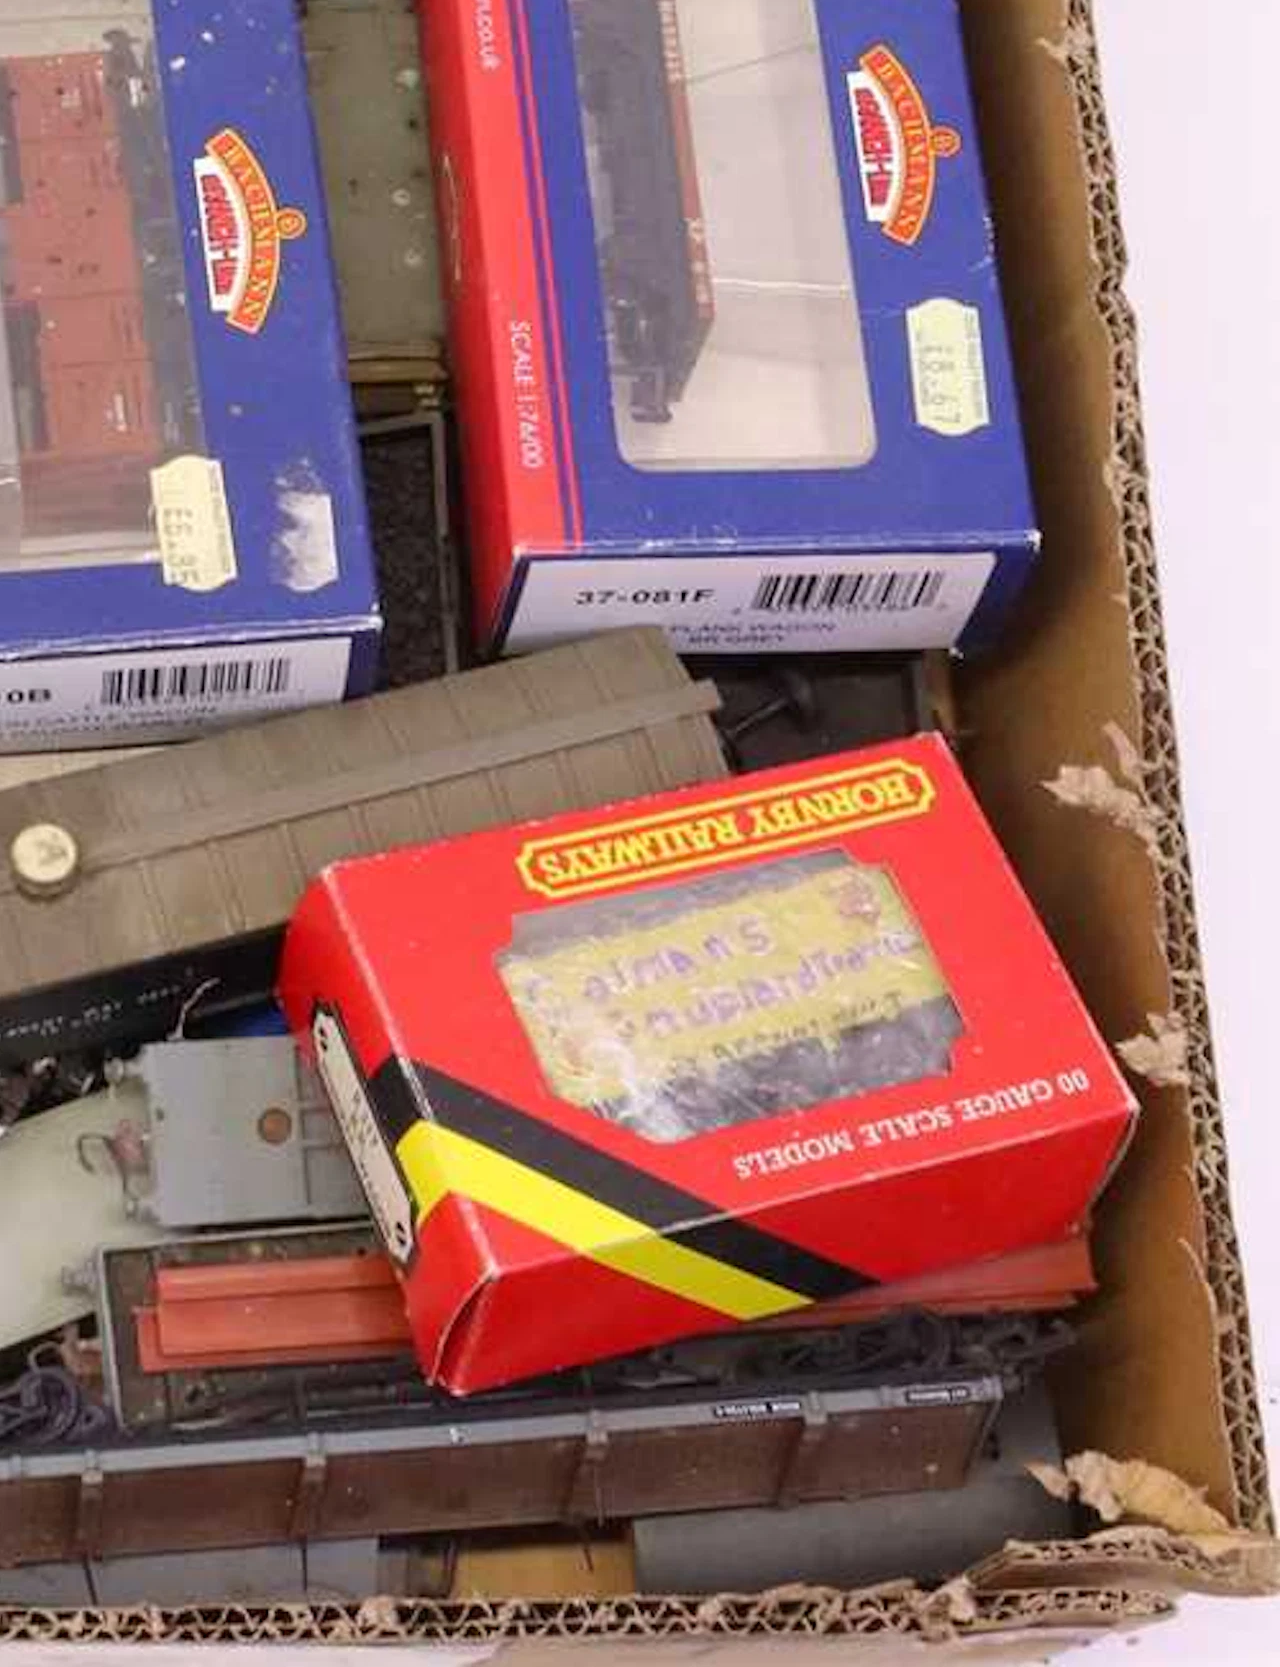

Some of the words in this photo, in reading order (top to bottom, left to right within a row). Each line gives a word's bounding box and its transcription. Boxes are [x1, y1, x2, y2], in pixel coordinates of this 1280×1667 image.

[874, 60, 930, 229] BACHMANN
[218, 140, 276, 323] BACHMANN
[509, 320, 537, 390] SCALE
[750, 772, 915, 827] HORNBY
[538, 817, 739, 883] RAILWAYS
[858, 1105, 954, 1148] SCALE
[958, 1077, 1054, 1122] GAUGE
[732, 1129, 855, 1180] MODELS
